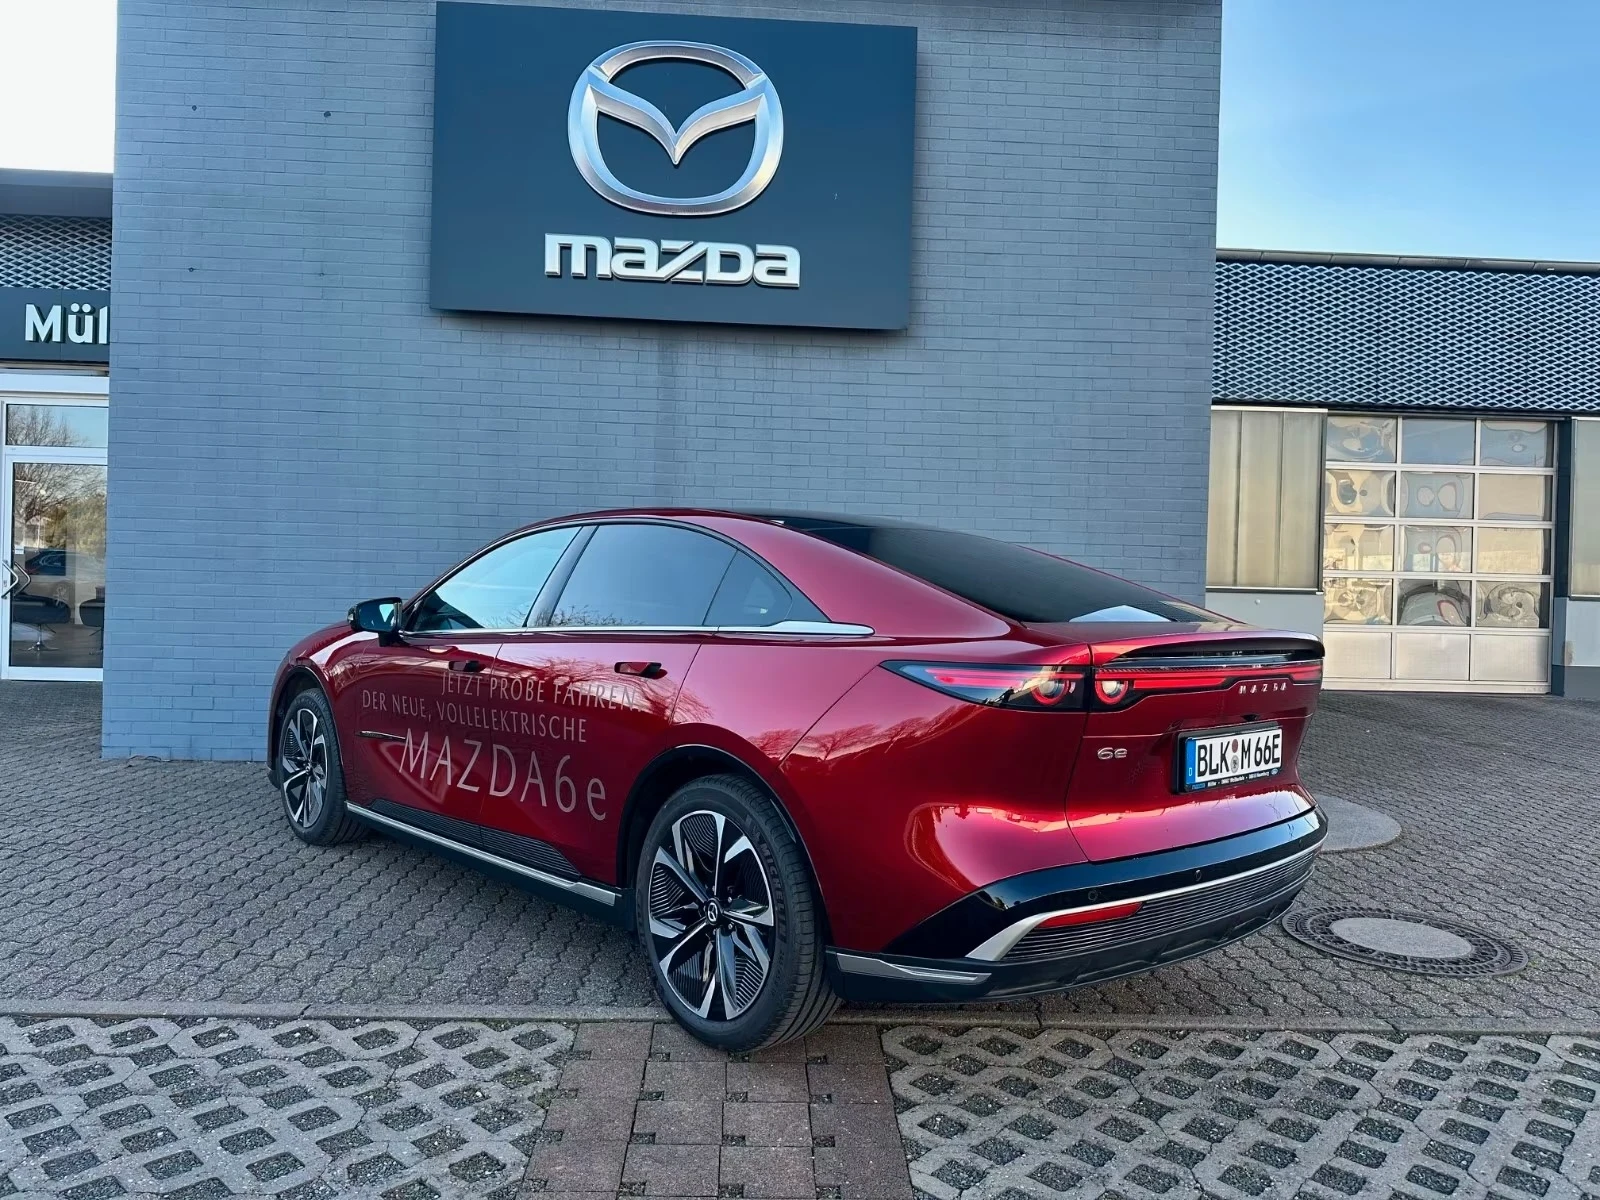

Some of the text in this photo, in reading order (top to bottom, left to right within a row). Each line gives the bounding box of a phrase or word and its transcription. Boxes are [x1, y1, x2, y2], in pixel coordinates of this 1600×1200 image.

[25, 302, 108, 344] Mül
[441, 671, 484, 697] JETZT
[489, 676, 546, 704] PROBE
[362, 689, 588, 743] DER NEUE, VOLLELEKTRISCHE
[1097, 746, 1128, 760] 6e
[1197, 733, 1281, 778] BLK M 66E
